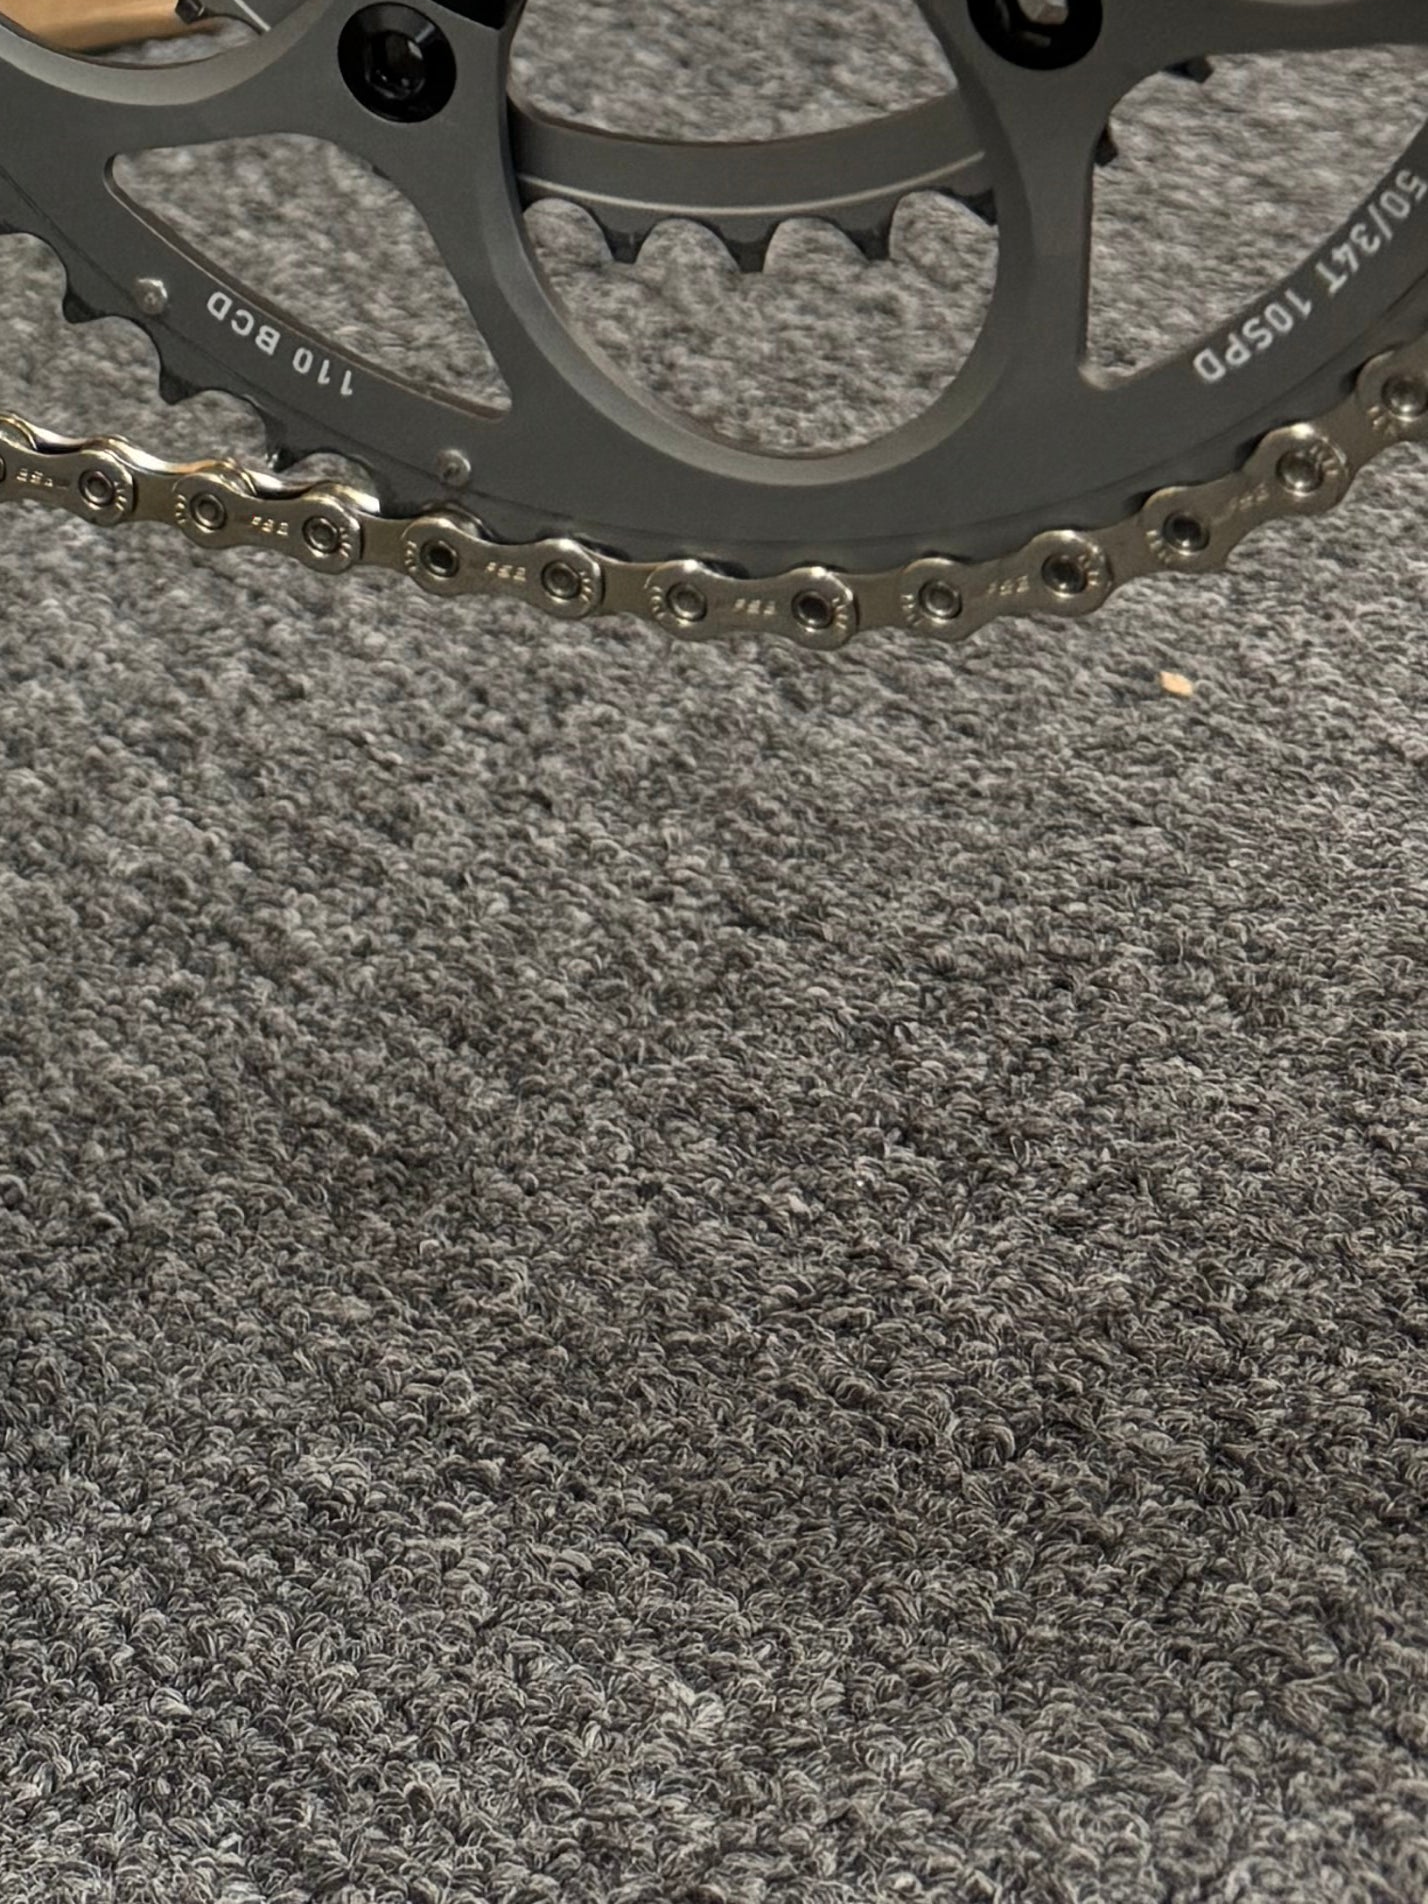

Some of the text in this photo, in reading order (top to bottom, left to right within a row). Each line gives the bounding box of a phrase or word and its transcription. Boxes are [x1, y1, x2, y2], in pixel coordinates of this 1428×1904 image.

[207, 291, 353, 396] 110 BCD
[1192, 167, 1428, 384] 50/34T 10SPD
